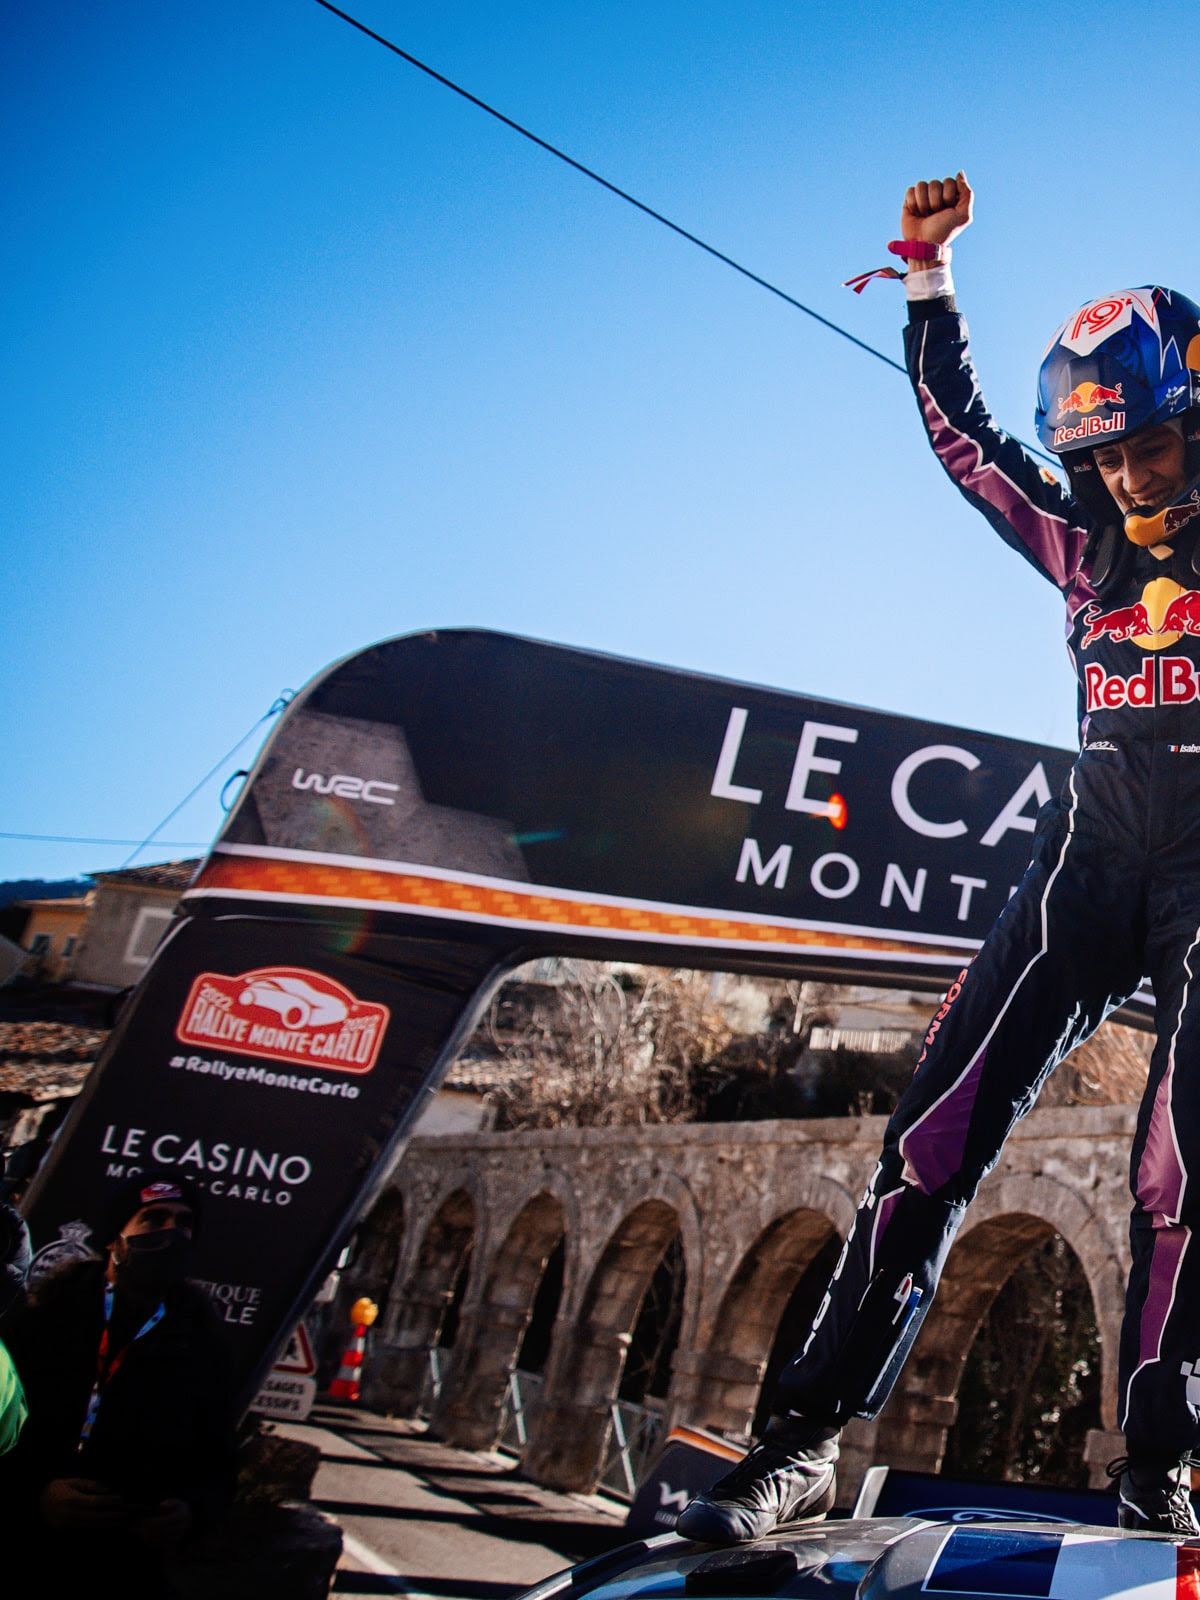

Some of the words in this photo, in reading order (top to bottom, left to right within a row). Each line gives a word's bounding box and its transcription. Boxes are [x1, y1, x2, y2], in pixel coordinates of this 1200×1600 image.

[1054, 418, 1087, 446] Red
[1087, 411, 1126, 437] Bull
[1084, 654, 1156, 713] Red
[291, 767, 401, 806] WRC
[710, 706, 860, 819] LE
[199, 982, 234, 1011] 2022
[186, 996, 250, 1042] RALLYE
[248, 1023, 376, 1063] MONTE-CARLO
[168, 1055, 361, 1100] #RallyeMonteCarlo
[101, 1124, 147, 1159] LE
[151, 1133, 312, 1186] CASINO
